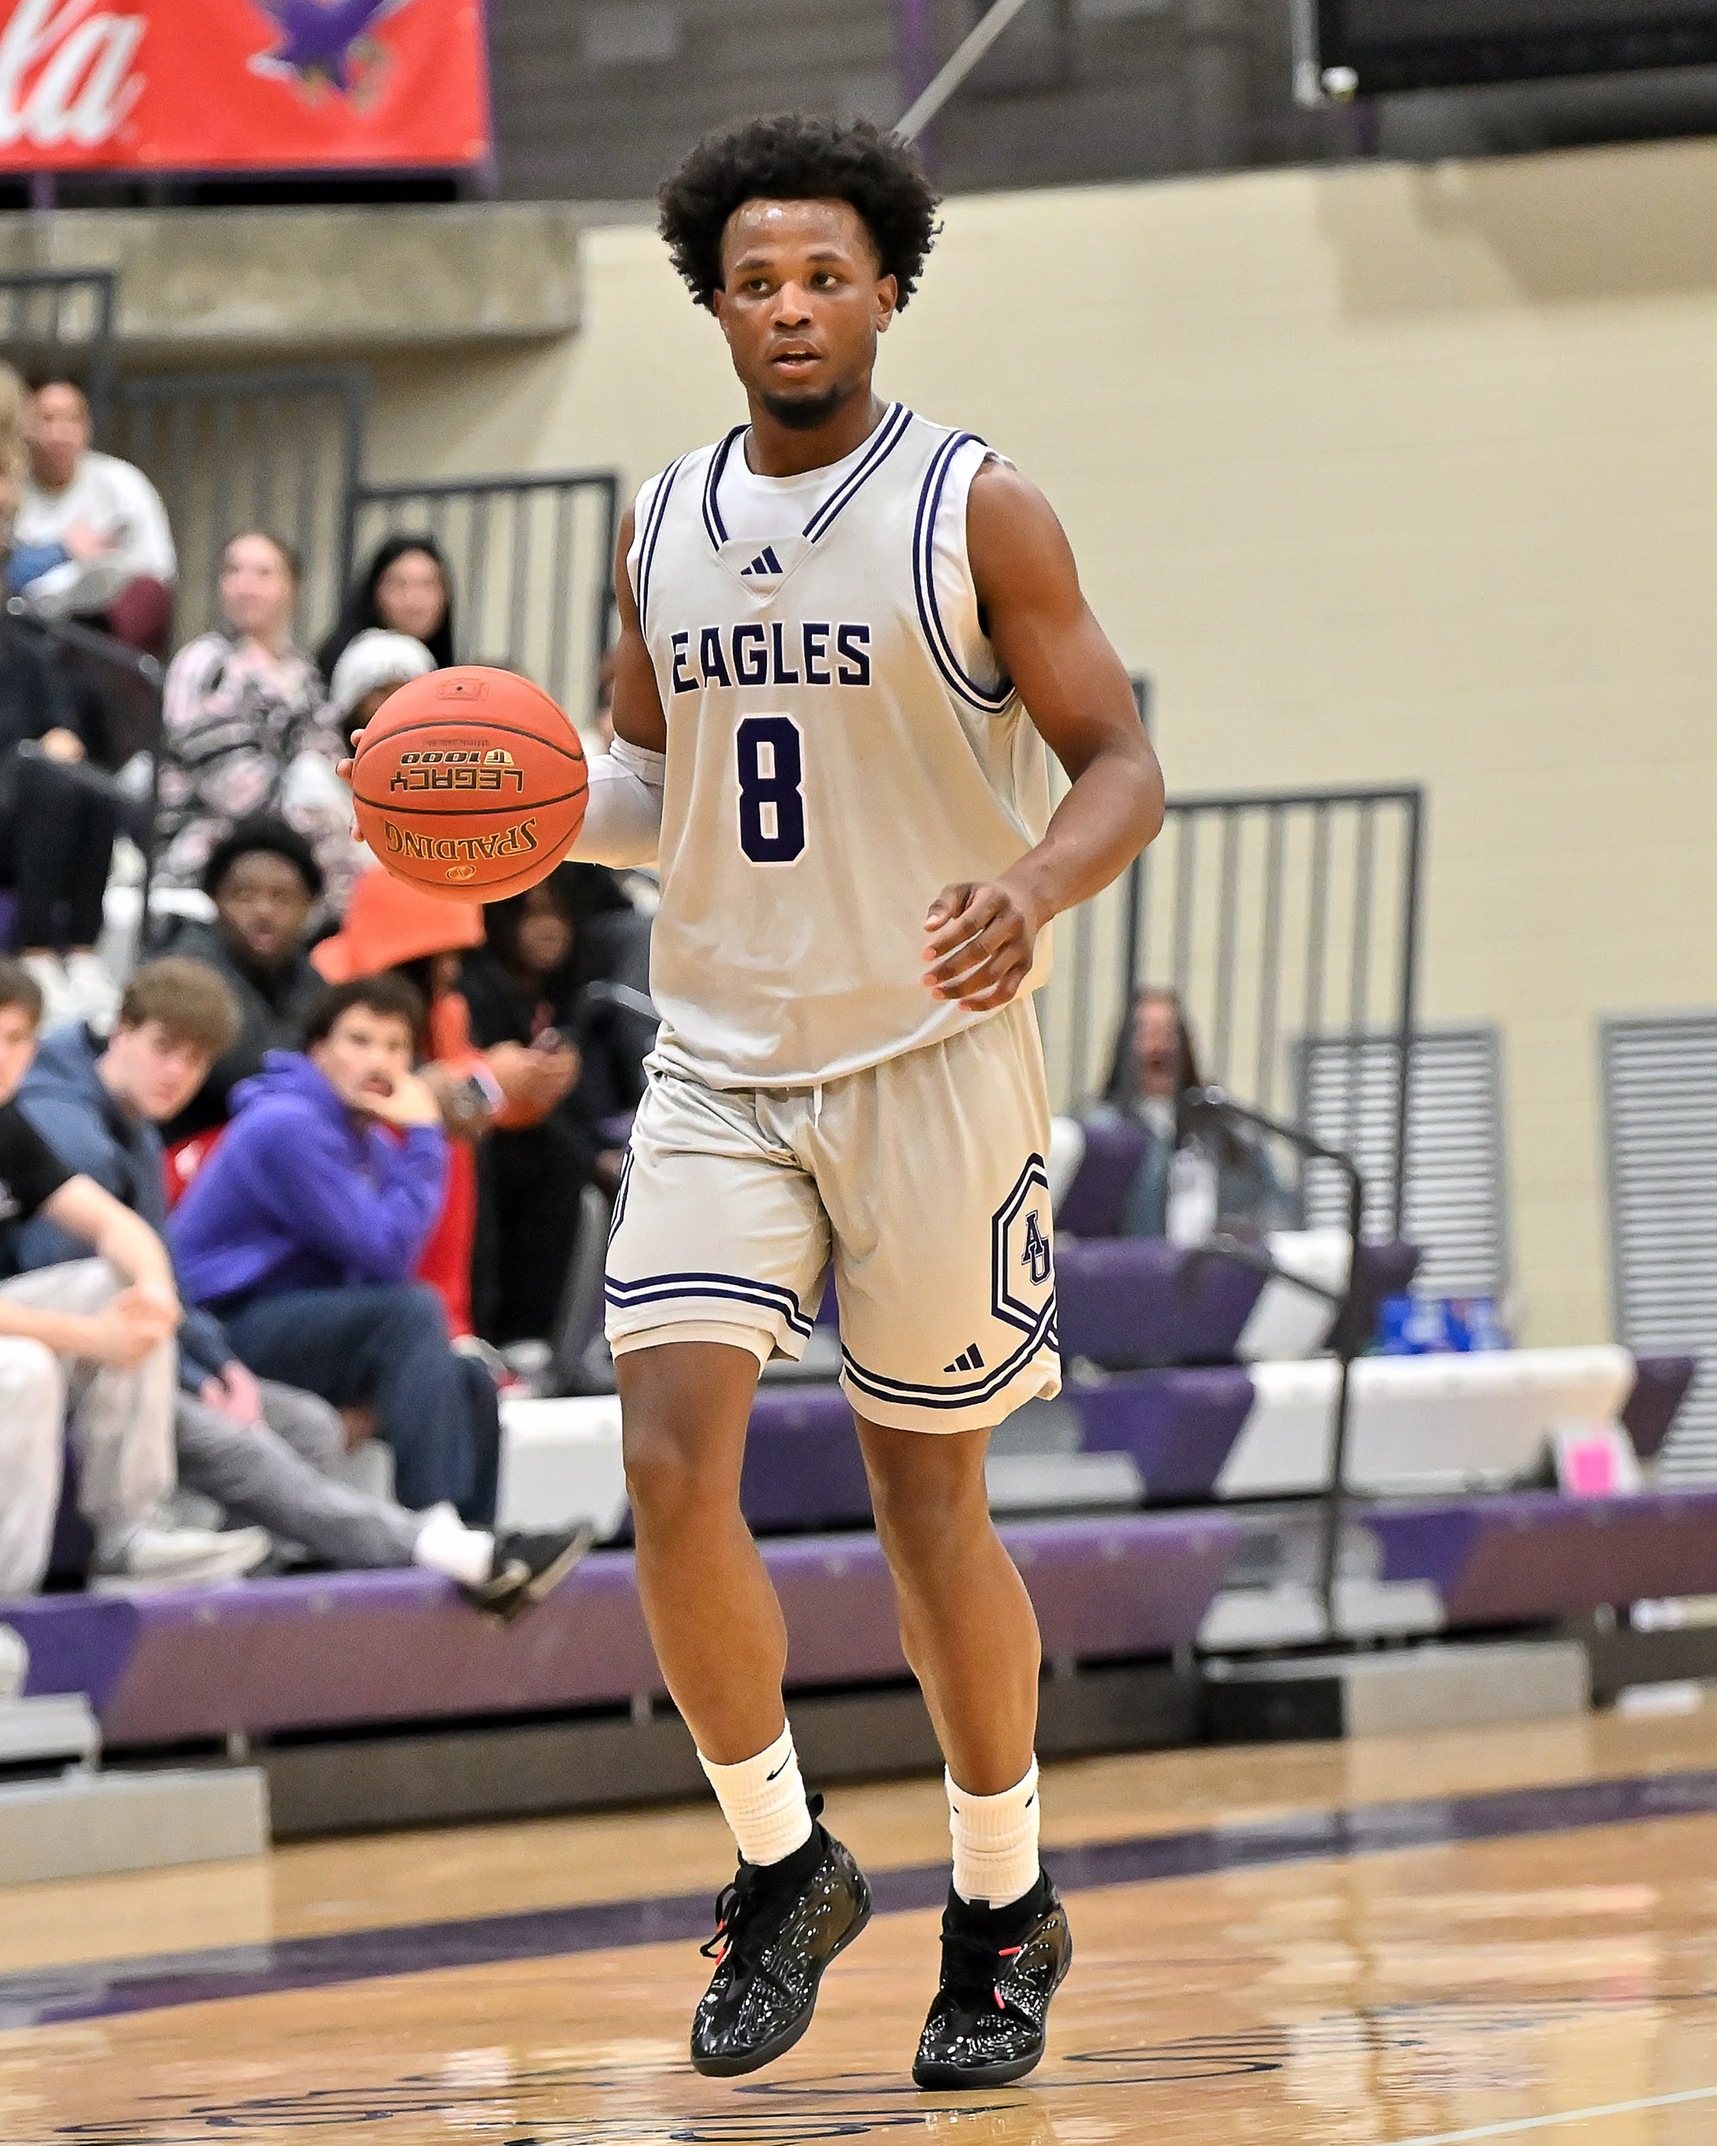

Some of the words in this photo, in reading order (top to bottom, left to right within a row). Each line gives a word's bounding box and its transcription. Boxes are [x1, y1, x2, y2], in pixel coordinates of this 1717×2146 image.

[670, 621, 871, 694] EAGLES
[400, 750, 482, 765] 1000
[390, 768, 524, 793] LEGACY
[735, 714, 808, 866] 8
[384, 817, 538, 860] SPALDING
